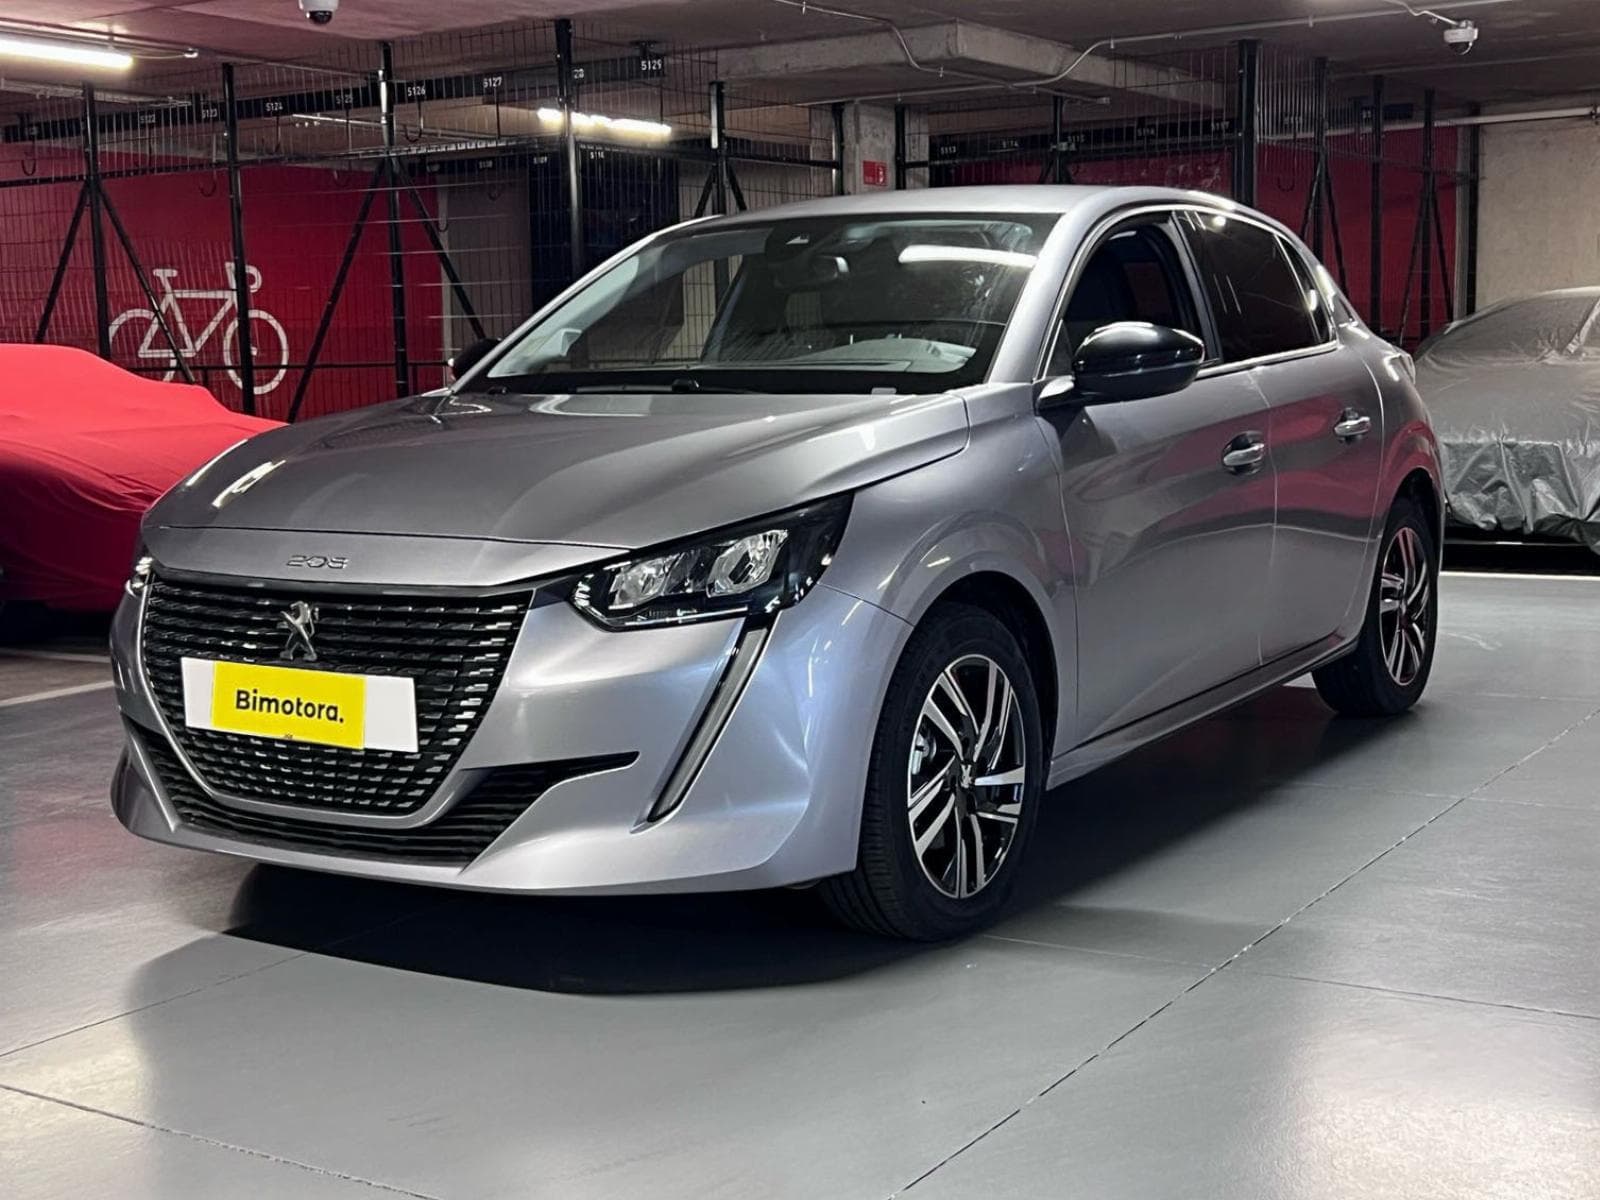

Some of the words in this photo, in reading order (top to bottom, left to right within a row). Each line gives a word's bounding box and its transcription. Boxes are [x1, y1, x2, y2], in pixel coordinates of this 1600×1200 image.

[641, 59, 662, 71] 5129
[574, 68, 585, 79] 28
[407, 86, 426, 97] 5126
[236, 688, 344, 723] Bimotora.
